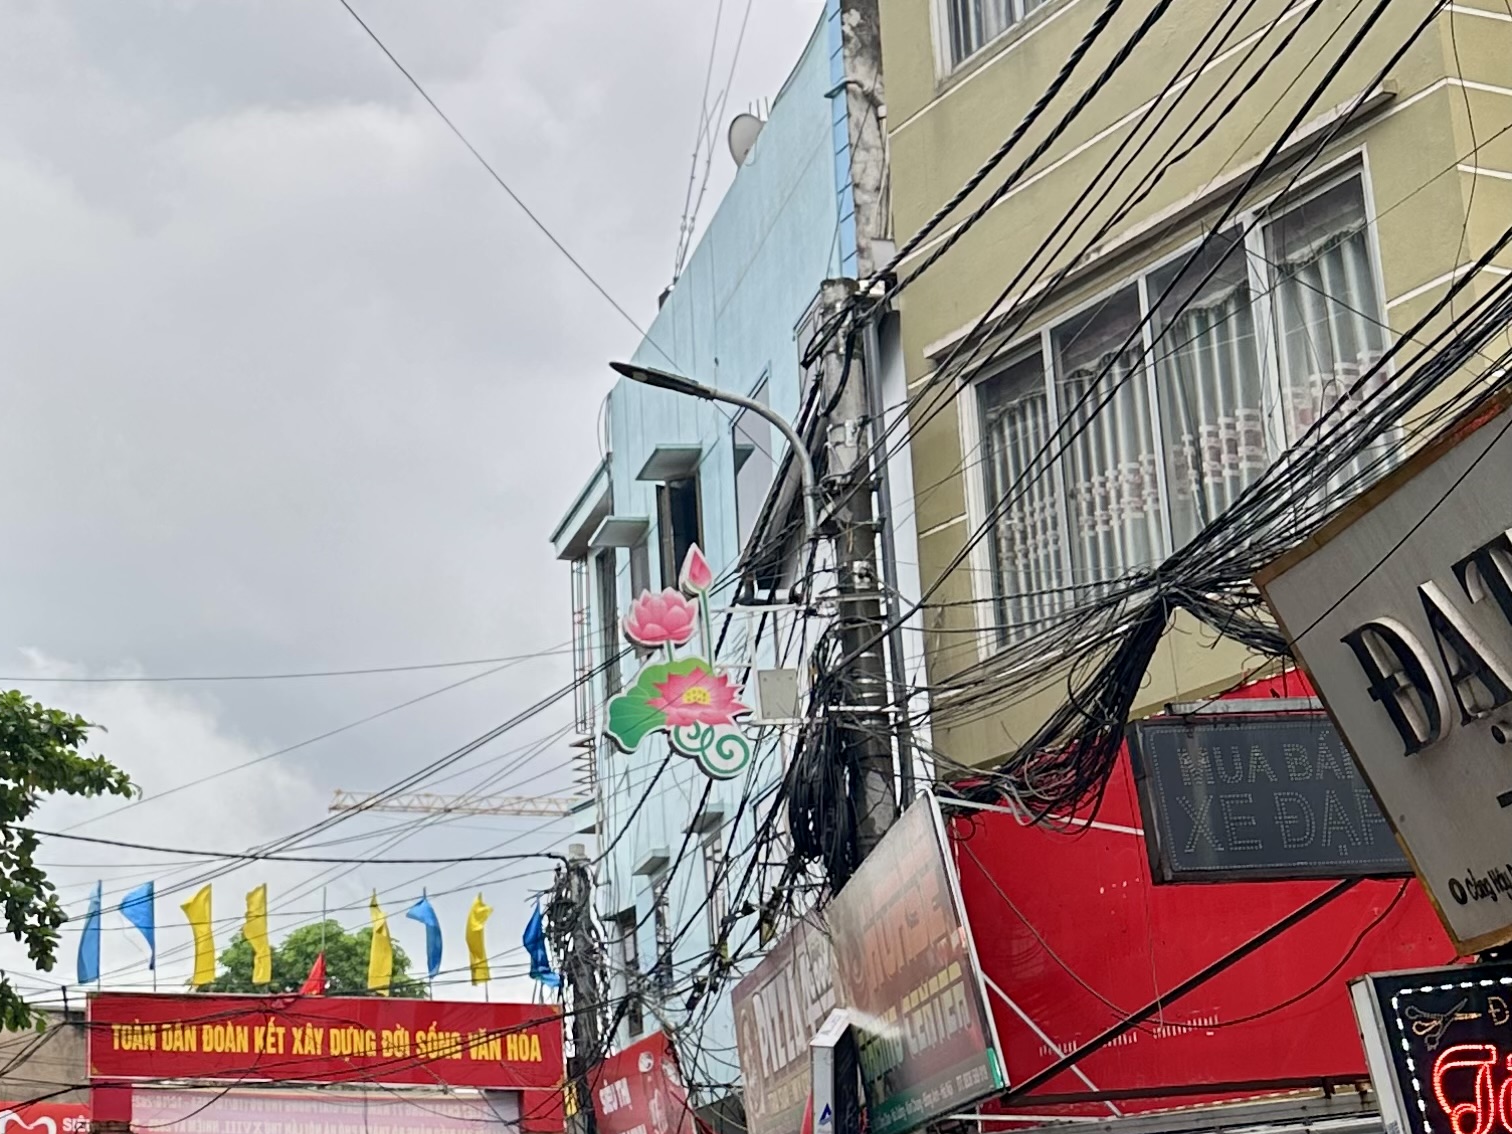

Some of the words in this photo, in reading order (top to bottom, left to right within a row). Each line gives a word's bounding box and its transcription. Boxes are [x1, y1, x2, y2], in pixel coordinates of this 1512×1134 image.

[1176, 744, 1278, 786] MUA
[1176, 793, 1263, 854] XE
[112, 1019, 156, 1051] TOÀN
[161, 1019, 197, 1052] DÂN
[201, 1021, 249, 1053] ĐOÀN
[254, 1017, 286, 1055] KẾT
[292, 1022, 324, 1056] XÂY
[329, 1026, 376, 1062] DỰNG
[382, 1023, 410, 1059] ĐỜI
[415, 1021, 462, 1060] SỐNG
[468, 1028, 502, 1061] VĂN
[506, 1029, 542, 1062] HÓA
